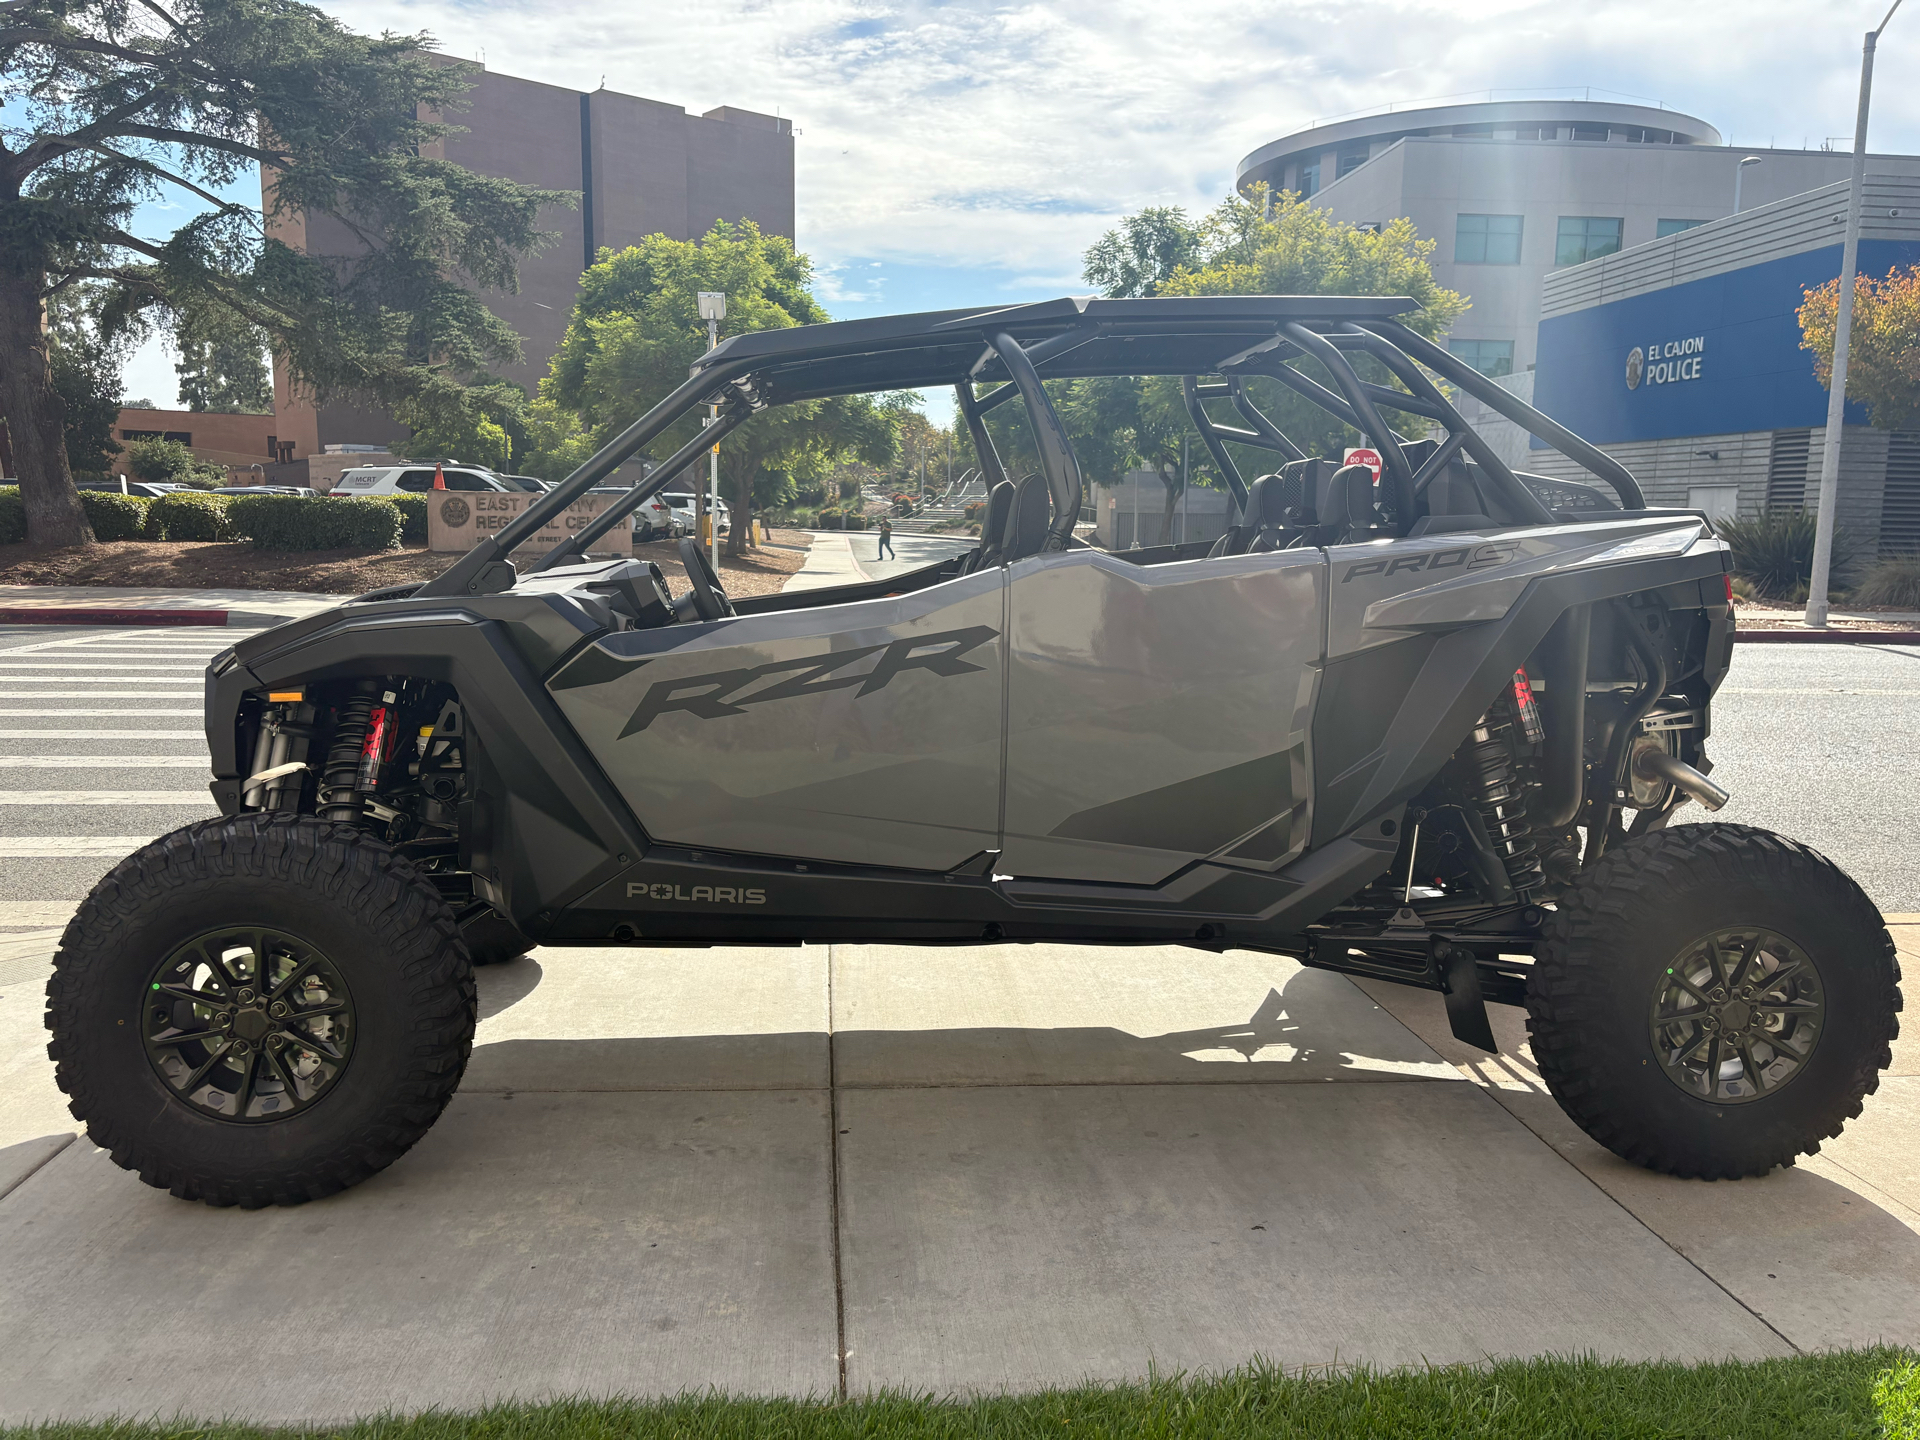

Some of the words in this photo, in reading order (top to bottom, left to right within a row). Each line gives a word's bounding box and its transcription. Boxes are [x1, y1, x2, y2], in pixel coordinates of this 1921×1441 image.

[1648, 345, 1661, 361] EL
[1664, 336, 1704, 358] CAJON
[1646, 357, 1702, 386] POLICE
[1350, 456, 1360, 464] DO
[1363, 456, 1377, 464] NOT
[476, 497, 519, 511] EAST
[616, 624, 1001, 741] RZR
[626, 882, 767, 905] POLARIS
